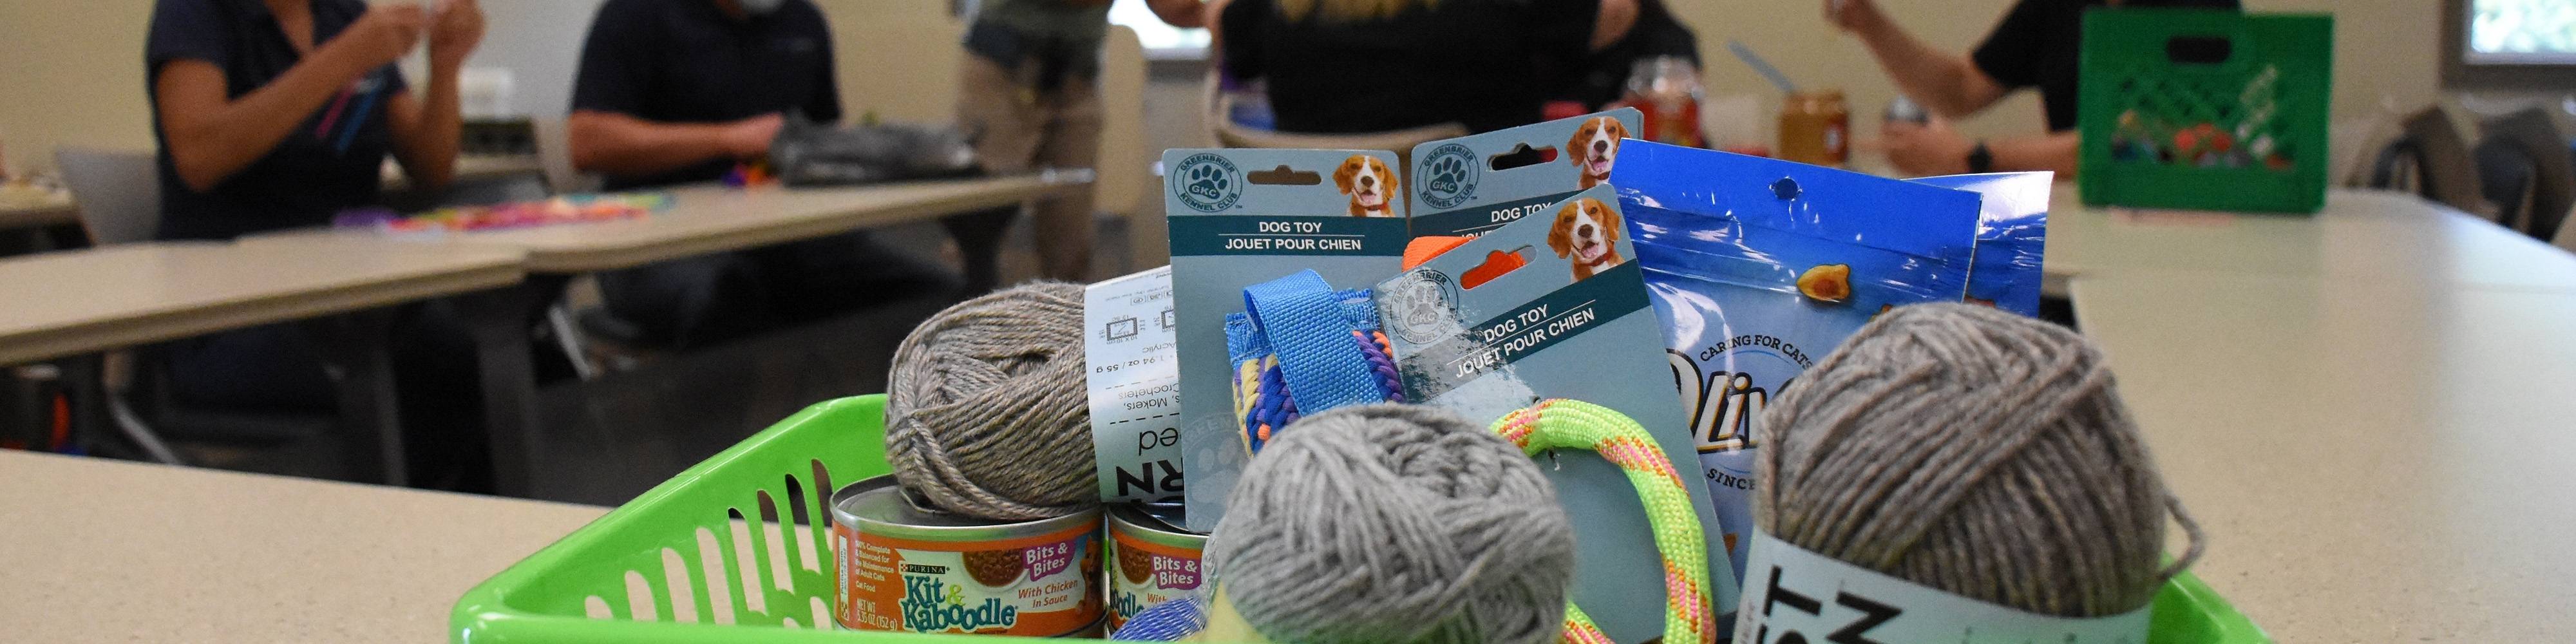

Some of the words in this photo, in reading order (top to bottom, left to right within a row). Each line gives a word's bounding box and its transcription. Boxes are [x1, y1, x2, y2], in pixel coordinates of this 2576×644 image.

[1180, 155, 1235, 173] GREENBRIER
[1424, 146, 1473, 167] GREENBRIER
[1191, 185, 1218, 197] GKC
[1432, 181, 1454, 191] GKC
[1180, 193, 1215, 211] KENNEL
[1218, 193, 1237, 209] CLUB
[1421, 191, 1453, 207] KENNEL
[1455, 184, 1473, 203] CLUB
[1491, 207, 1520, 222] DOG
[1259, 222, 1291, 232] DOG
[1293, 222, 1321, 232] TOY
[1225, 238, 1271, 249] JOUET
[1275, 239, 1316, 250] POUR
[1319, 239, 1361, 250] CHIEN
[1484, 319, 1517, 343] DOG
[1518, 303, 1548, 327] TOY
[1142, 341, 1177, 353] Acrylic
[1456, 346, 1501, 378] JOUET
[1504, 328, 1546, 356] POUR
[1548, 308, 1595, 336] CHIEN
[1700, 334, 1751, 362] CARING
[1754, 334, 1781, 350] FOR
[1782, 343, 1814, 370] CATS
[1106, 364, 1119, 372] 55
[1118, 383, 1179, 399] Crocheters
[1124, 397, 1168, 410] Makers,
[1026, 546, 1054, 565] Bits
[1057, 542, 1068, 554] &
[909, 565, 944, 573] PURINA
[1033, 557, 1065, 578] Bites
[1153, 556, 1180, 571] Bits
[1184, 560, 1198, 573] &
[1159, 571, 1194, 585] Bites
[904, 576, 945, 609] Kit
[946, 584, 966, 606] &
[1018, 586, 1042, 599] With
[1045, 580, 1078, 594] Chicken
[857, 598, 866, 611] NET
[867, 601, 876, 613] WT
[1032, 600, 1041, 608] In
[1043, 594, 1068, 606] Sauce
[901, 598, 1016, 633] Kaboodle
